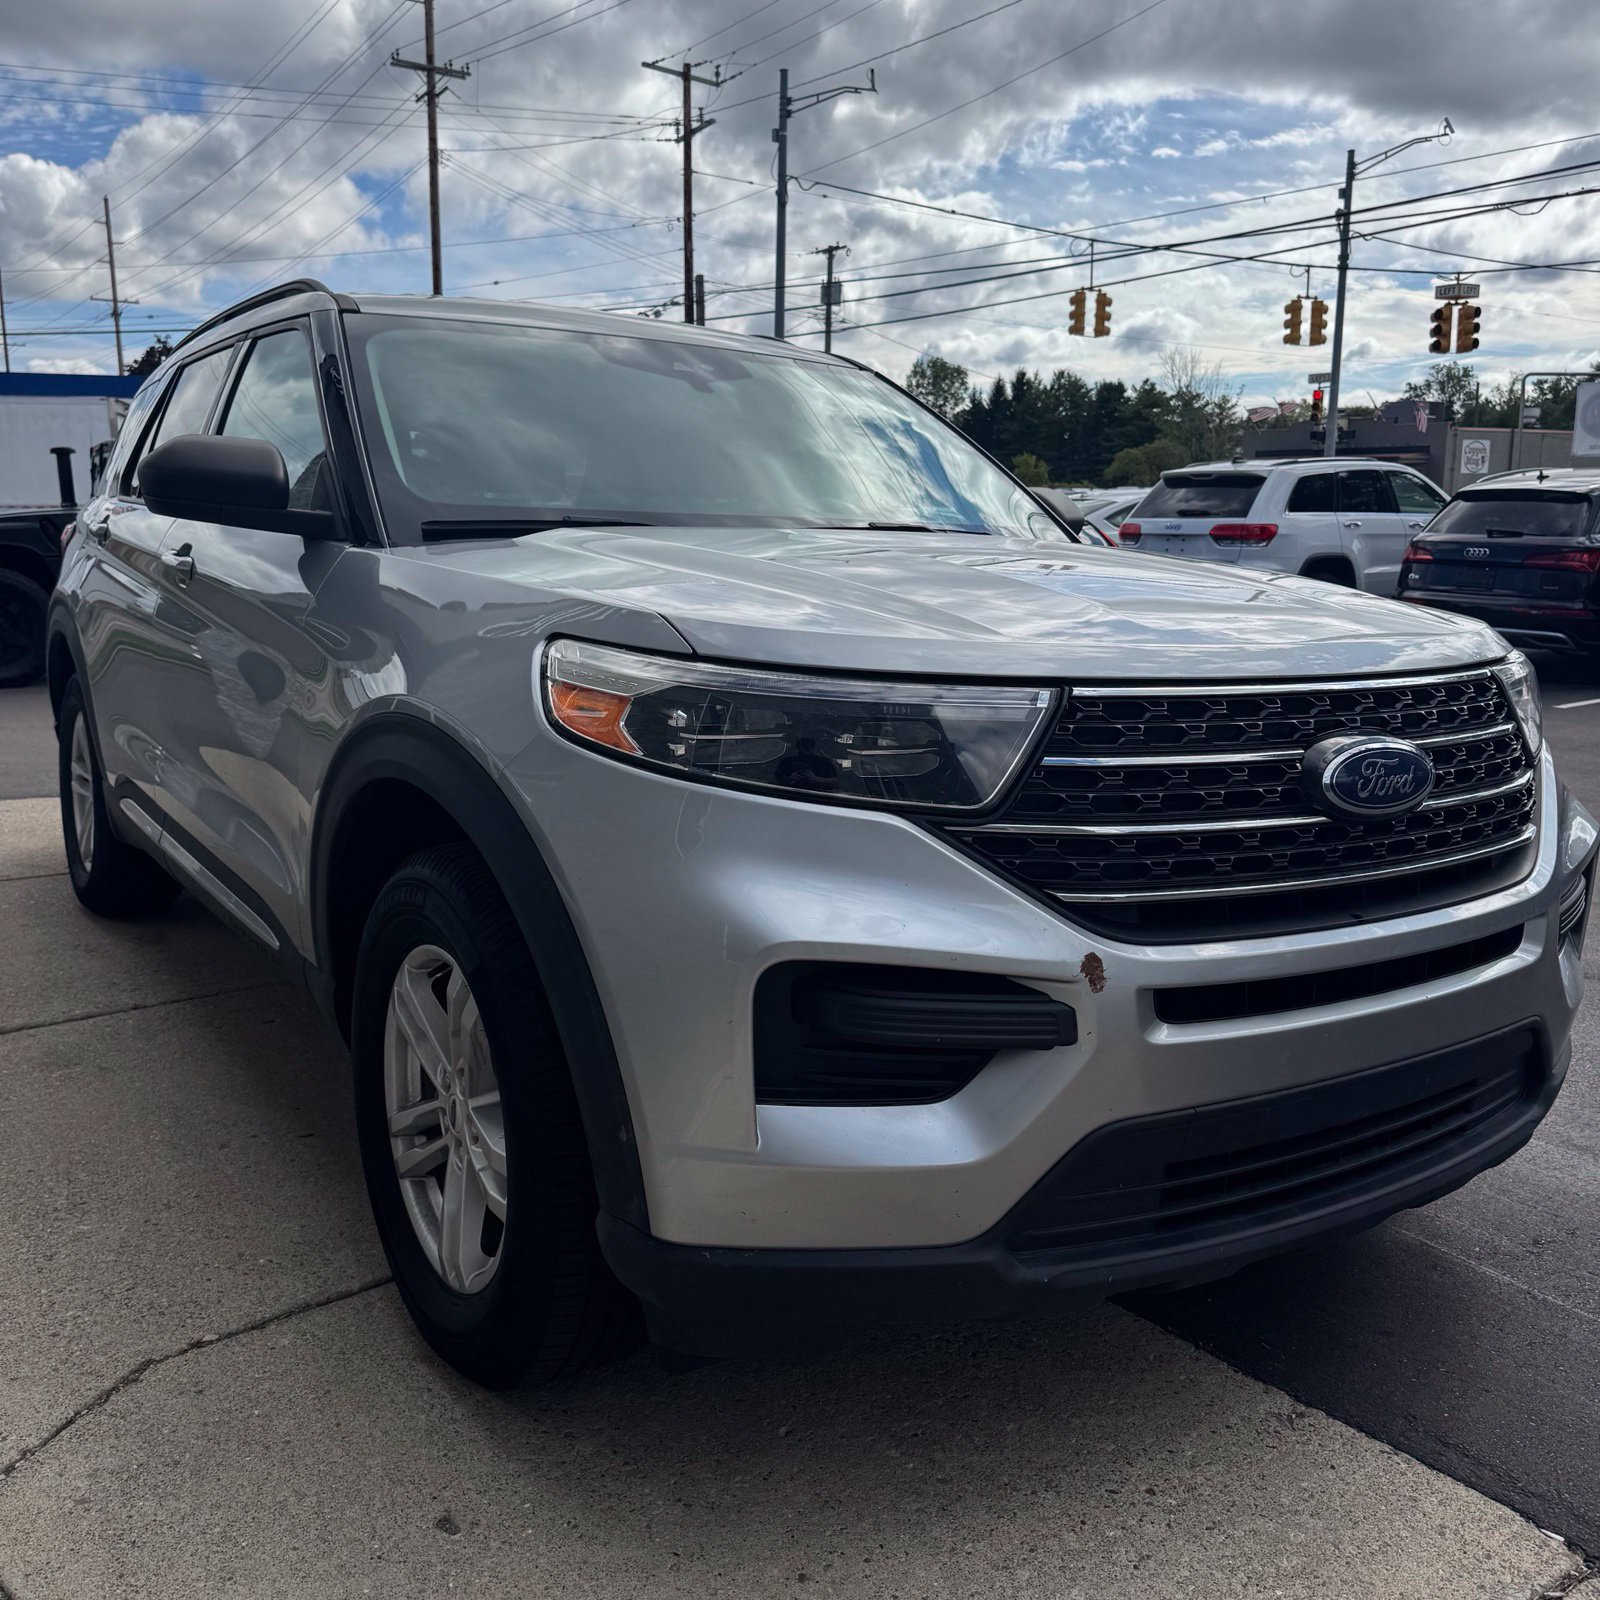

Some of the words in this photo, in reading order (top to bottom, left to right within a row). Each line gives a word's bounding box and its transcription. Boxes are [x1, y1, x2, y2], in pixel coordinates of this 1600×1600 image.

[1440, 286, 1456, 296] LEFT
[1463, 286, 1477, 295] LEFT
[561, 666, 638, 690] EXPLORER
[1357, 758, 1416, 798] Ford
